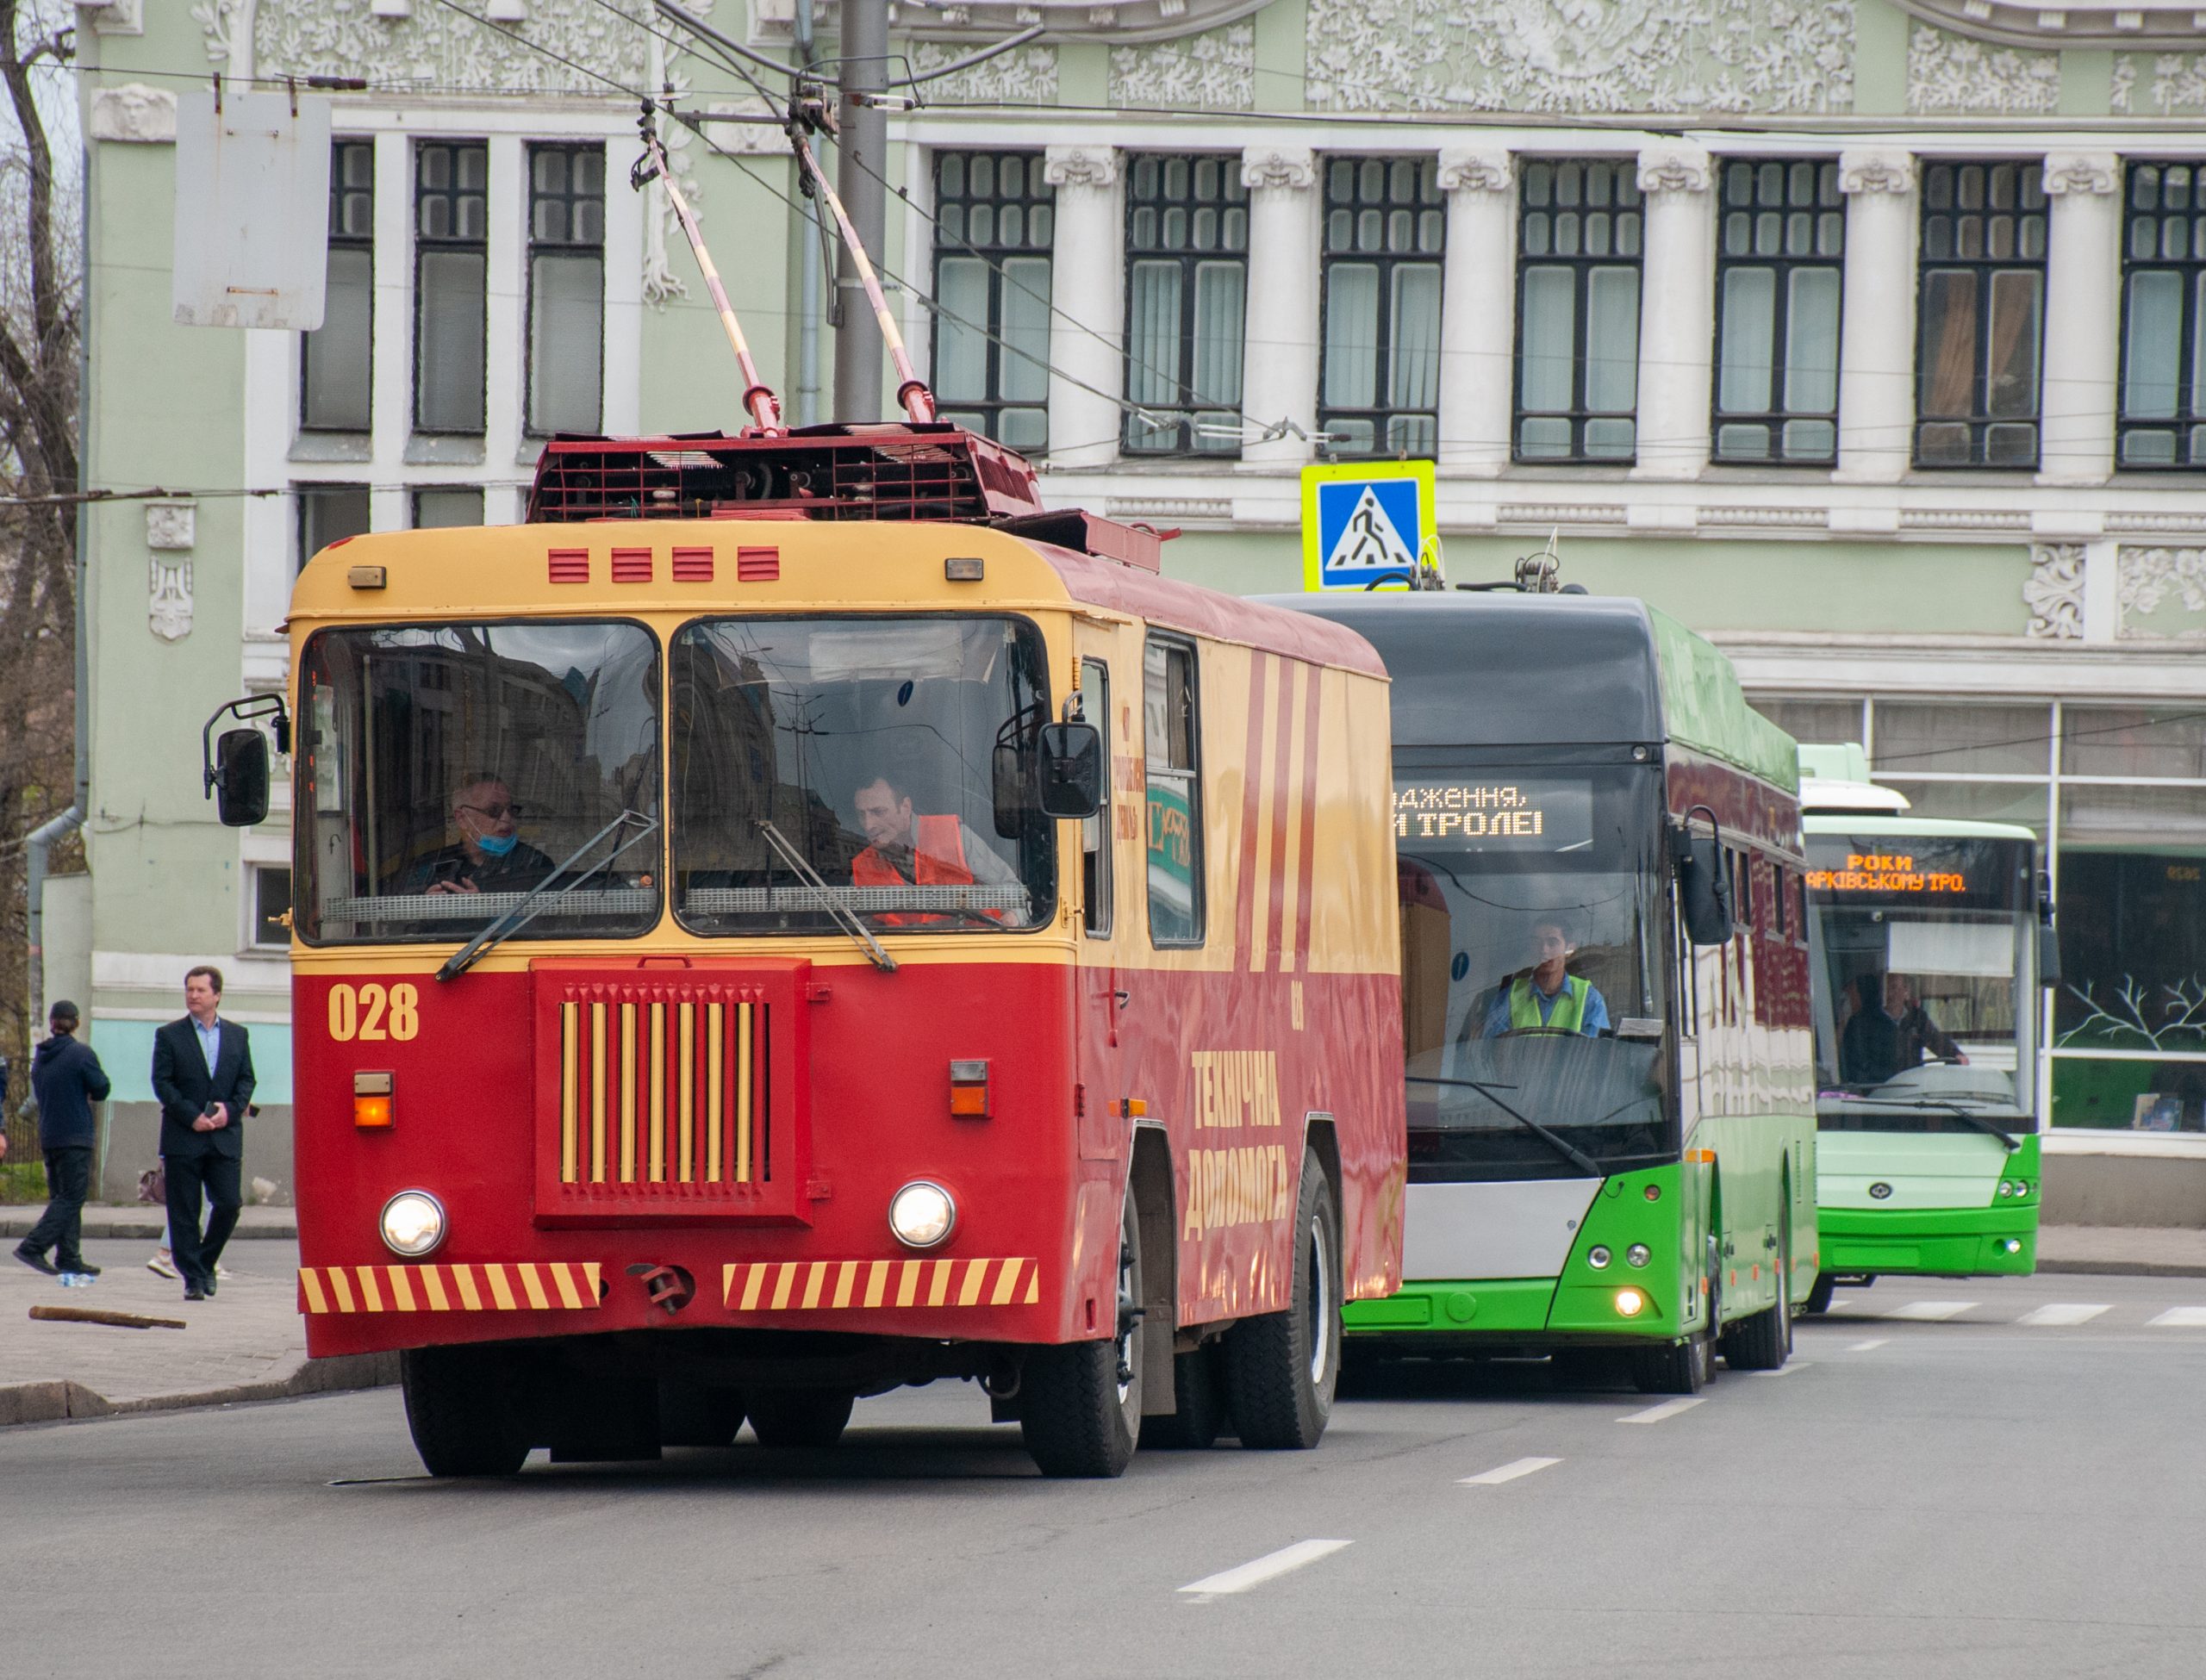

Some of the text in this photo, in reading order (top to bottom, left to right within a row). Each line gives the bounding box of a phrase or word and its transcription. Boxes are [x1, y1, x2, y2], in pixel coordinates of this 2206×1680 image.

[1847, 854, 1913, 871] РОКИ
[328, 983, 419, 1041] 028
[1191, 1050, 1281, 1129] ТЕХНІЧНА
[1183, 1145, 1287, 1241] ДОПОМОГА
